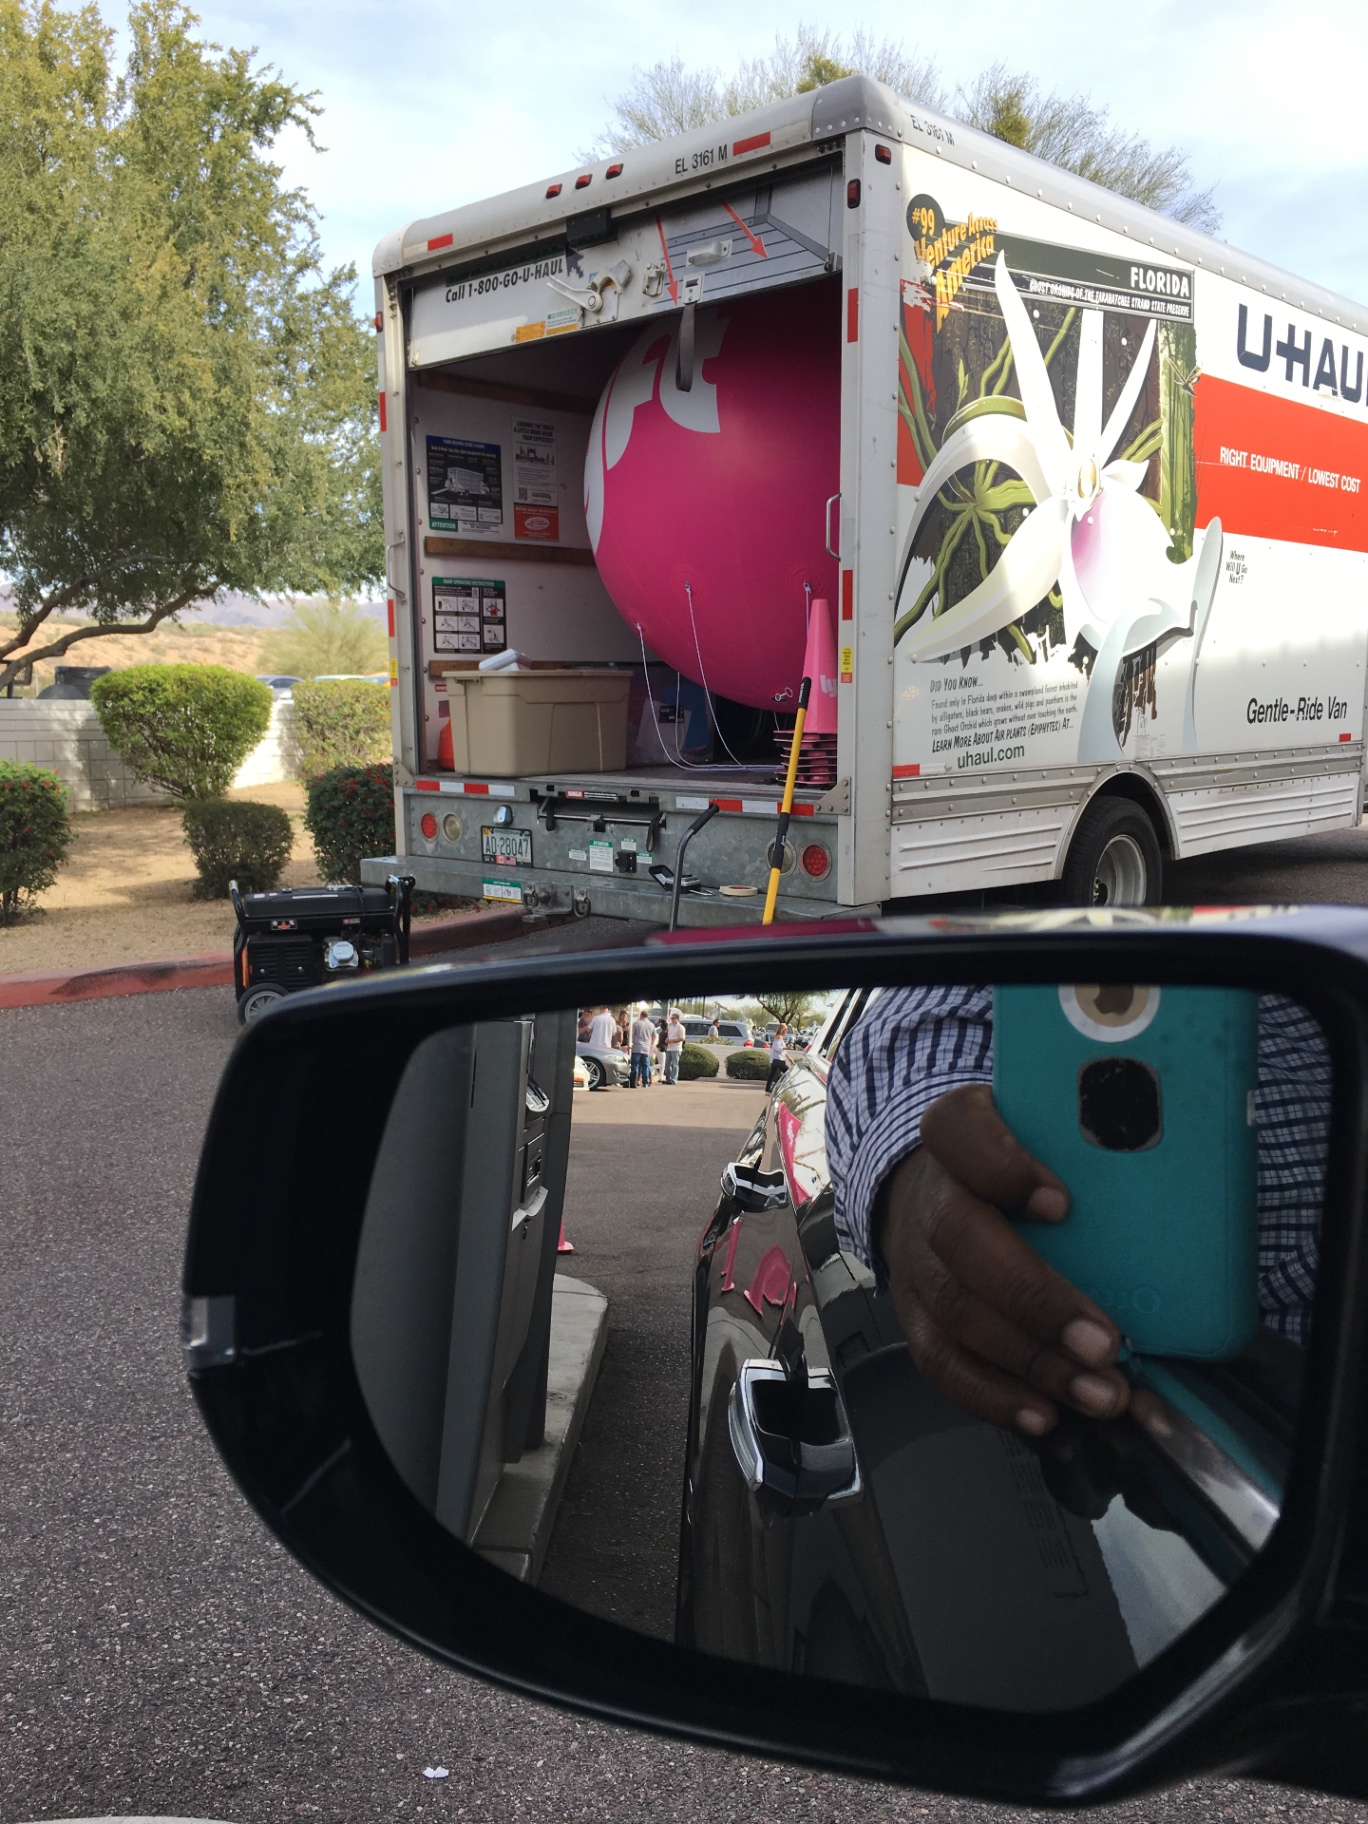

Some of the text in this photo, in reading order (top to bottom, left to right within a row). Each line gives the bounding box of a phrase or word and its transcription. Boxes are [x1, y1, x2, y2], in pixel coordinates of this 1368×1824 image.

[675, 144, 728, 174] EL 3161 M
[912, 207, 935, 236] #99
[914, 211, 998, 269] Venture Across
[446, 258, 564, 303] Call 1-800-GO-U-HAUL
[1130, 266, 1190, 297] FLORIDA
[1151, 300, 1166, 313] STATE
[1220, 446, 1248, 468] RIGHT
[1250, 454, 1300, 479] EQUIPMENT
[1308, 468, 1340, 488] LOWEST
[1341, 476, 1360, 493] COST
[432, 521, 456, 529] ATTENTION
[1230, 550, 1245, 561] Where
[1226, 562, 1248, 575] Will U Go
[1229, 574, 1244, 584] Next?
[930, 680, 942, 693] DID
[944, 678, 957, 691] YOU
[932, 698, 947, 710] Found
[949, 698, 960, 708] only
[961, 697, 966, 705] in
[968, 694, 984, 705] Florida
[986, 693, 997, 703] deep
[999, 690, 1013, 700] within
[1019, 685, 1044, 697] swampland
[932, 714, 938, 724] by
[966, 707, 979, 718] black
[1015, 700, 1024, 709] wild
[1025, 701, 1034, 710] pigs
[1036, 698, 1044, 707] and
[1046, 696, 1064, 706] panthers
[1328, 696, 1348, 720] Van
[944, 724, 959, 734] Ghost
[960, 720, 977, 731] Orchid
[978, 717, 992, 728] which
[994, 718, 1007, 727] grows
[1009, 713, 1026, 723] without
[1038, 708, 1056, 719] touching
[932, 738, 952, 753] LEARN
[954, 735, 972, 749] MORE
[972, 731, 994, 746] ABOUT
[994, 729, 1005, 741] AIR
[1006, 726, 1026, 740] PLANTS
[1028, 720, 1061, 738] (EPIPHYTES)
[957, 745, 1025, 769] uhaul.com
